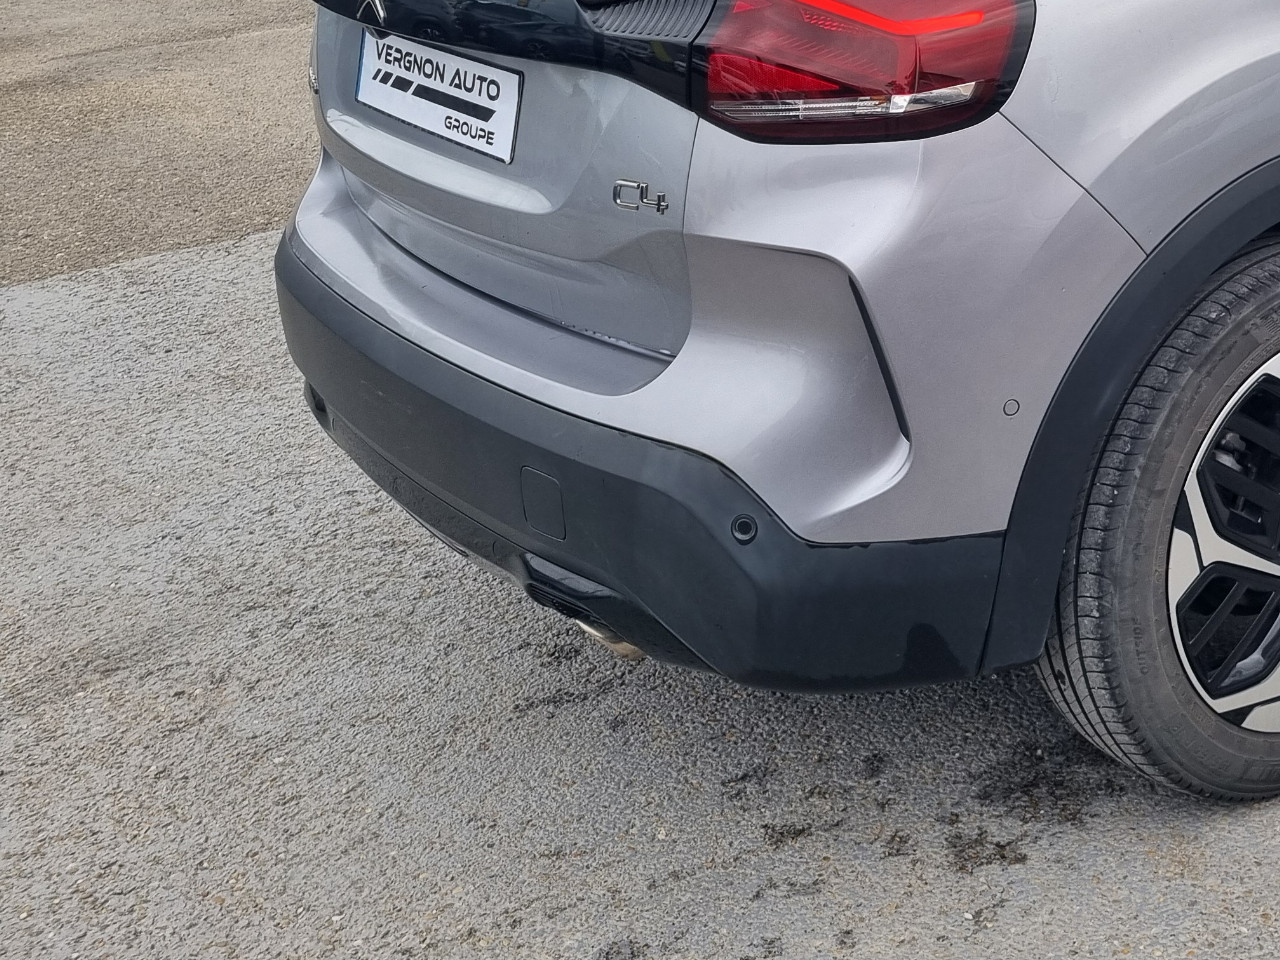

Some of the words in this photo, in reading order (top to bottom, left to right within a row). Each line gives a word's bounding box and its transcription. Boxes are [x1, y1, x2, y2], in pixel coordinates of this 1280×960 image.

[376, 39, 446, 86] VERGNON
[448, 66, 501, 102] AUTO
[443, 114, 496, 147] GROUPE
[612, 177, 669, 215] C4
